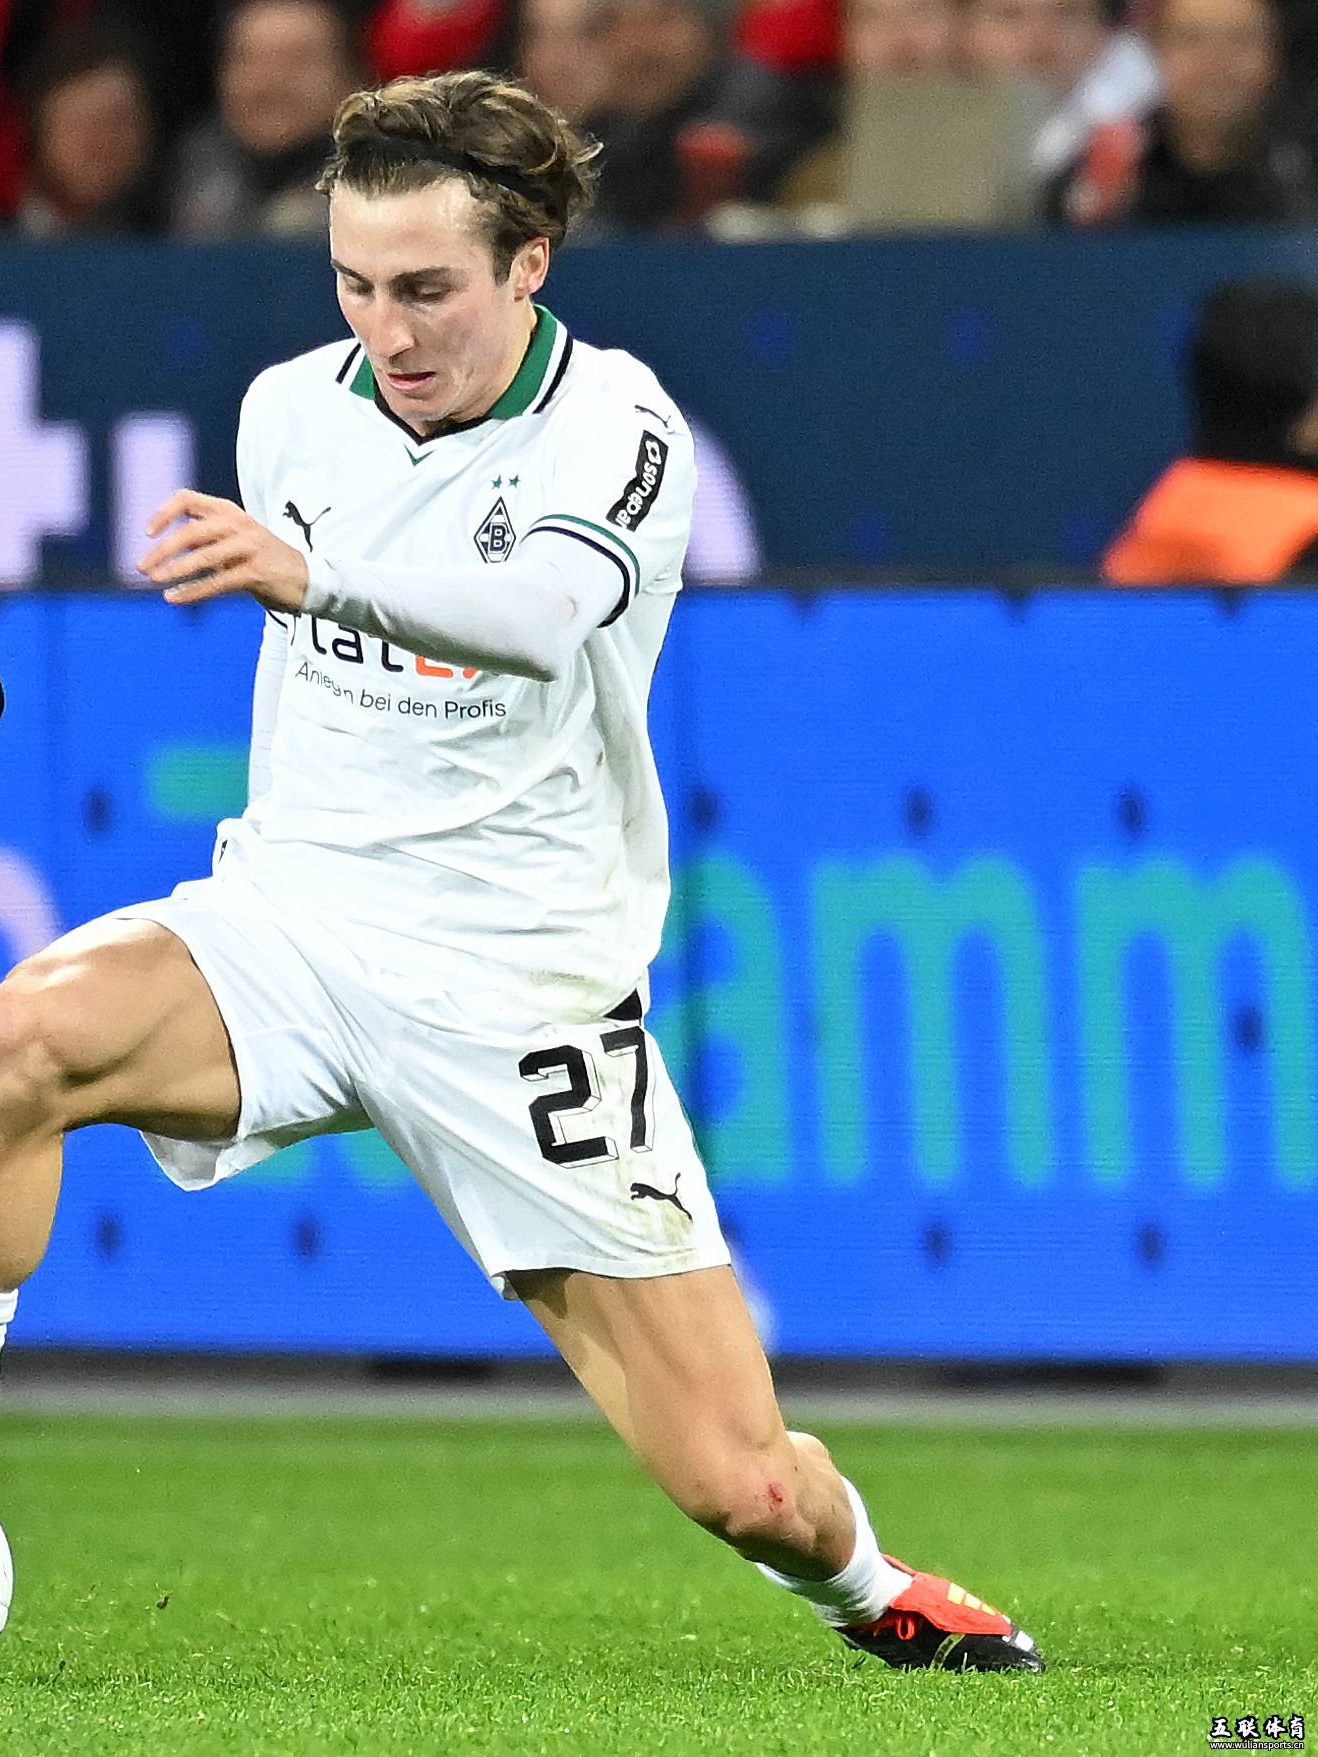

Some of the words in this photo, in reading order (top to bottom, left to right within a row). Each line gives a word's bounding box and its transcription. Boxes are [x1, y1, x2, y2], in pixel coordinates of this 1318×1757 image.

[359, 688, 391, 712] bei
[397, 697, 437, 719] den
[444, 699, 507, 720] Profis
[518, 1025, 656, 1170] 27
